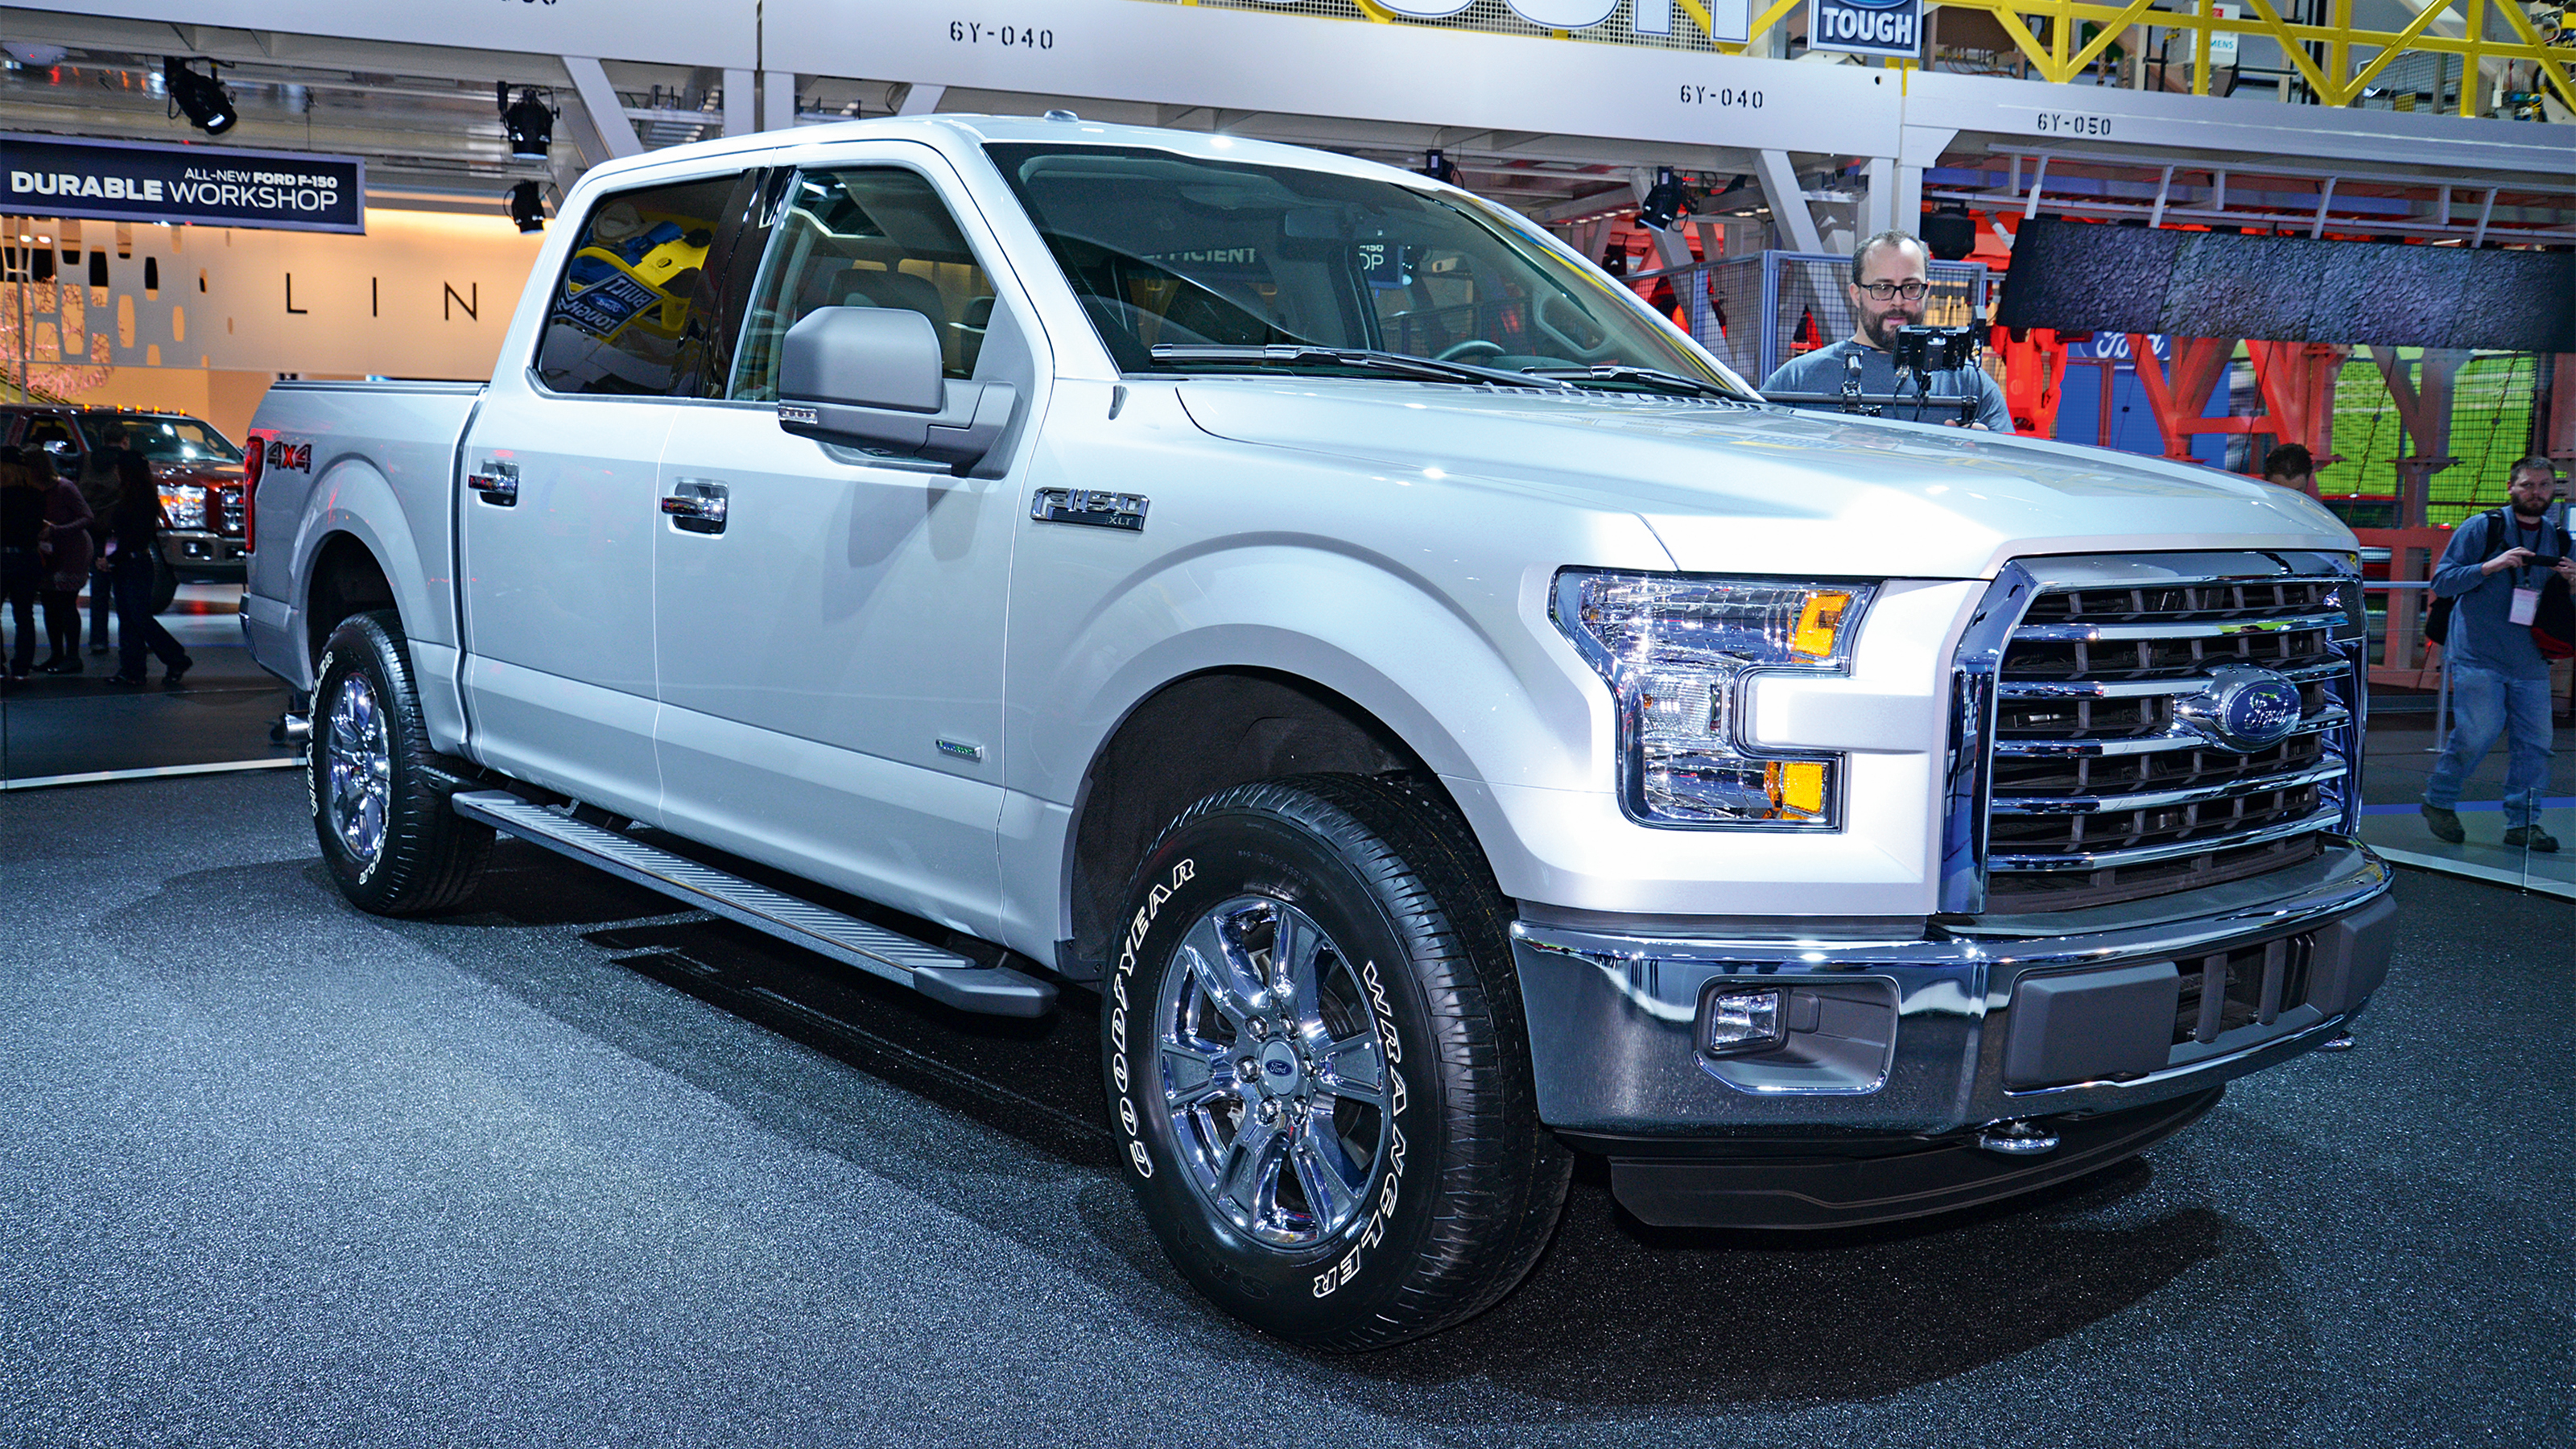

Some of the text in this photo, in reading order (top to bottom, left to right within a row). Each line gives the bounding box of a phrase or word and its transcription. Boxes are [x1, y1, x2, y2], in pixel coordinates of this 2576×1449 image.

[950, 21, 1053, 49] 6Y-040
[1822, 6, 1913, 45] TOUGH
[1680, 85, 1763, 109] 6Y-040
[2037, 113, 2111, 135] 6Y-050
[184, 167, 338, 189] ALL-NEW FORD F-150
[10, 171, 338, 211] DURABLE WORKSHOP
[1141, 247, 1257, 264] ICIENT
[2095, 332, 2165, 358] Fod
[1108, 515, 1133, 526] XLT
[1112, 858, 1195, 1179] GOODYEAR
[1269, 1062, 1287, 1074] Ford
[1312, 960, 1407, 1298] WRANGLER
